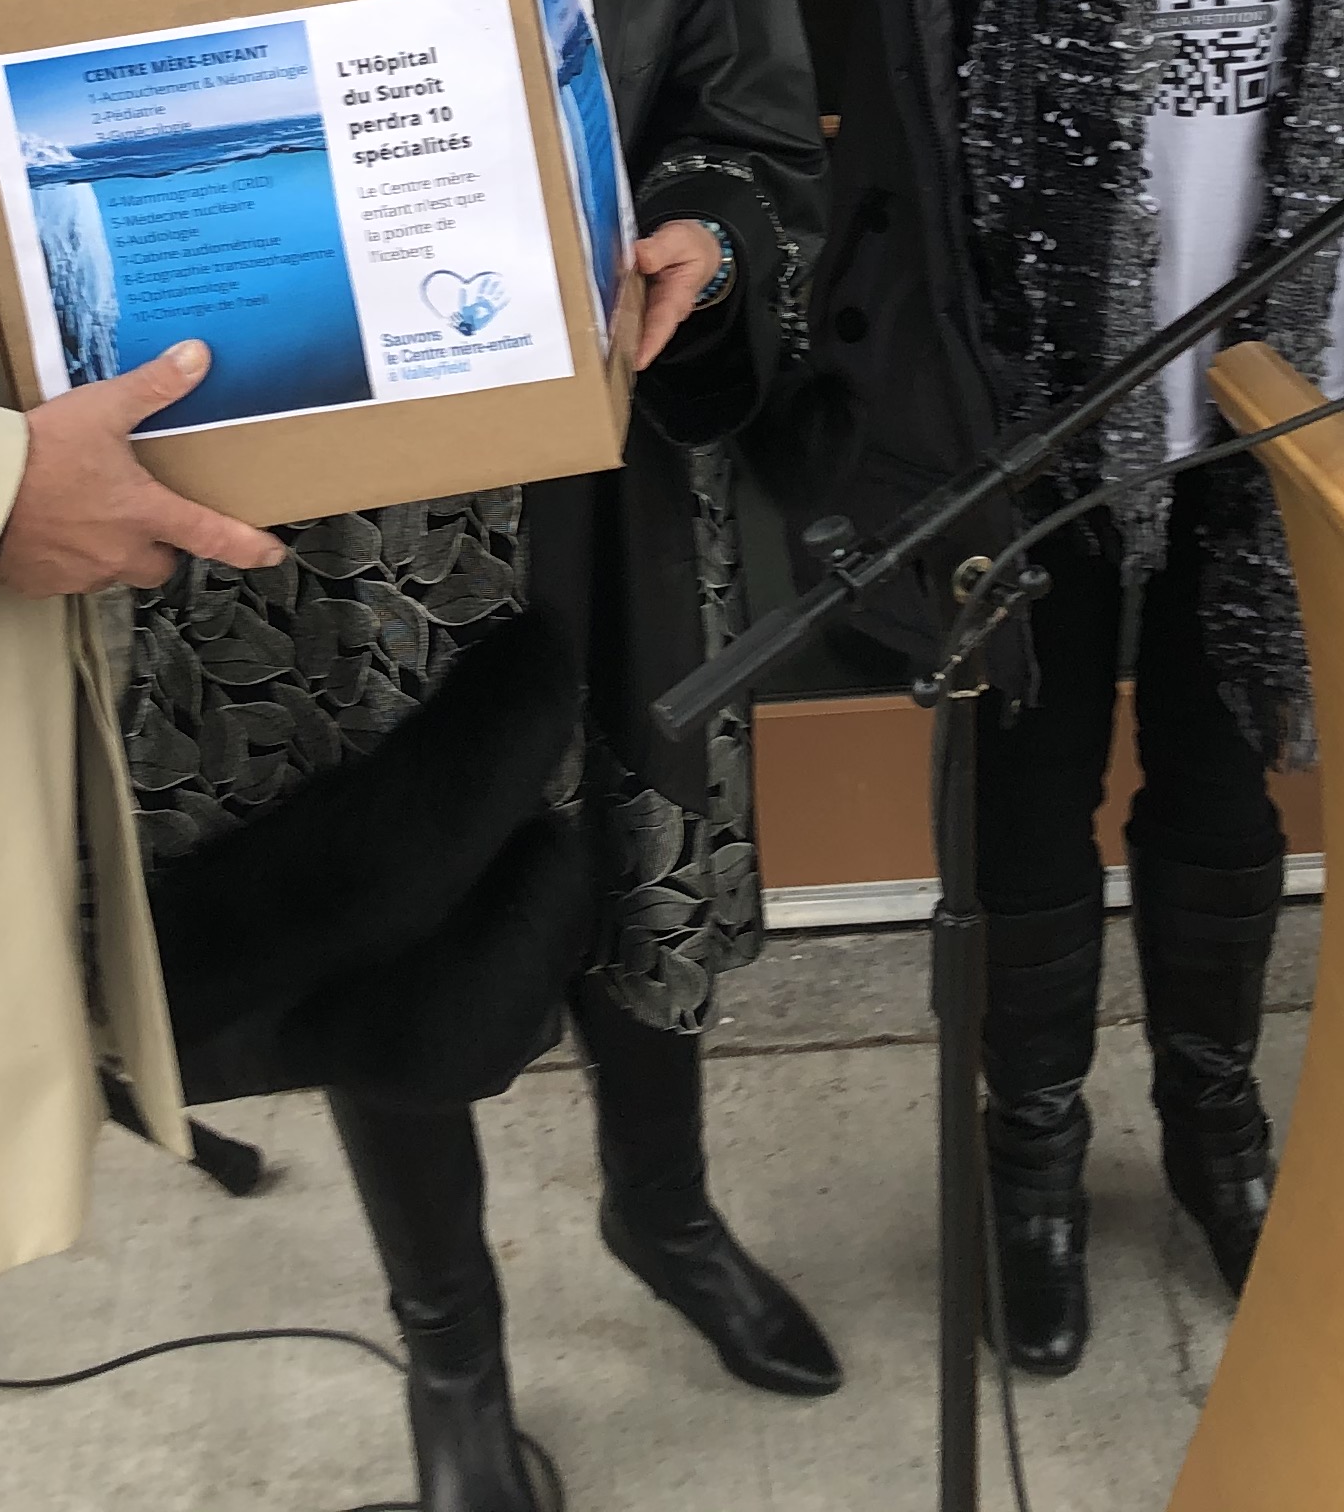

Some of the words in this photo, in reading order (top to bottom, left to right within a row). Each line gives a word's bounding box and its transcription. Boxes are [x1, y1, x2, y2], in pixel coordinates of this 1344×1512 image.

[83, 62, 148, 83] CENTRE
[150, 44, 269, 73] MÈRE-ENFANT
[337, 46, 438, 78] L'Hôpital
[343, 88, 371, 106] du
[376, 77, 445, 102] Suroît
[348, 111, 423, 140] perdra
[426, 105, 454, 124] 10
[353, 132, 473, 168] spécialités
[357, 185, 378, 199] Le
[379, 179, 432, 196] Centre
[434, 171, 481, 188] mère-
[361, 204, 413, 221] enfant
[454, 192, 486, 208] que
[364, 229, 381, 243] la
[382, 223, 433, 244] pointe
[435, 217, 457, 231] de
[380, 330, 443, 348] Sauvons
[401, 345, 448, 363] Centre
[449, 333, 533, 357] mère-enfant
